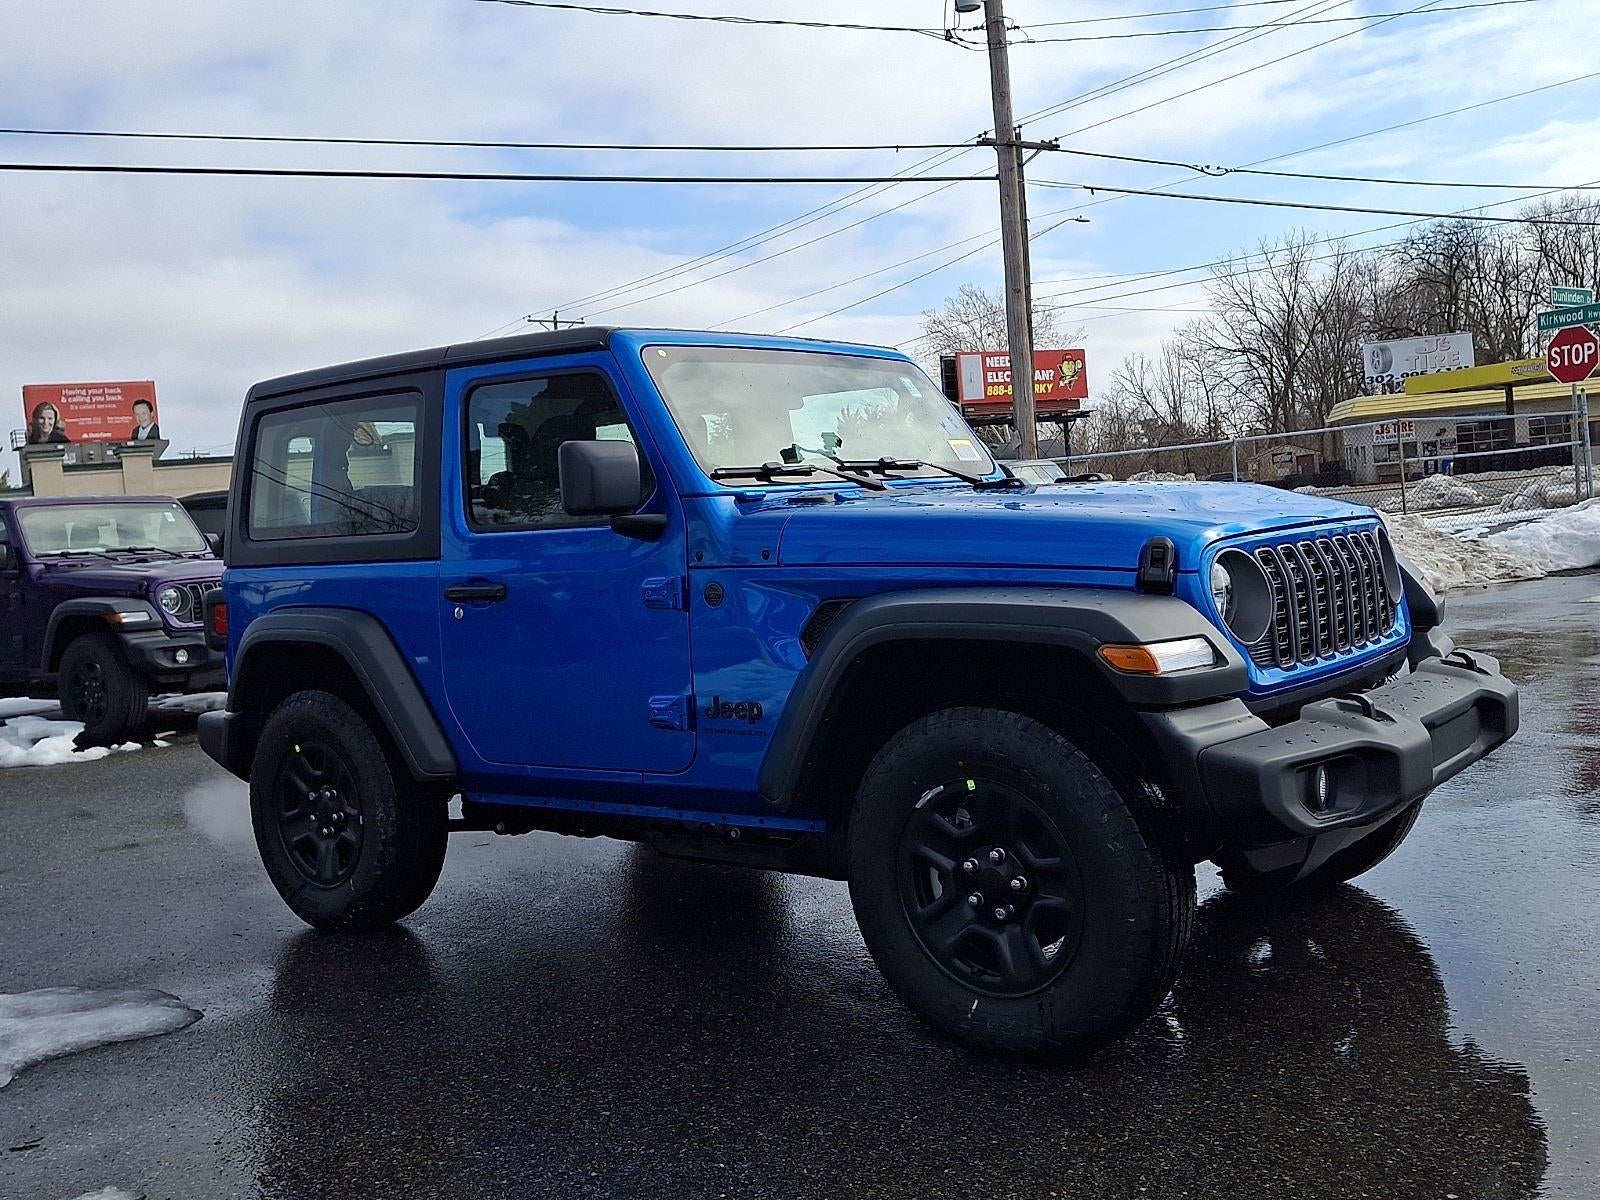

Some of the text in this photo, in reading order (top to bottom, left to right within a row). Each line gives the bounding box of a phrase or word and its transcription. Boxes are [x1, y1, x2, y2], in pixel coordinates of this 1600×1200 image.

[1553, 290, 1585, 304] Dunlinden
[1540, 309, 1584, 326] Kirkwood
[1407, 351, 1460, 371] TIRE
[1550, 341, 1596, 368] STOP
[62, 386, 121, 396] Having your back
[68, 395, 91, 403] calling
[91, 394, 105, 402] you
[704, 695, 764, 725] Jeep
